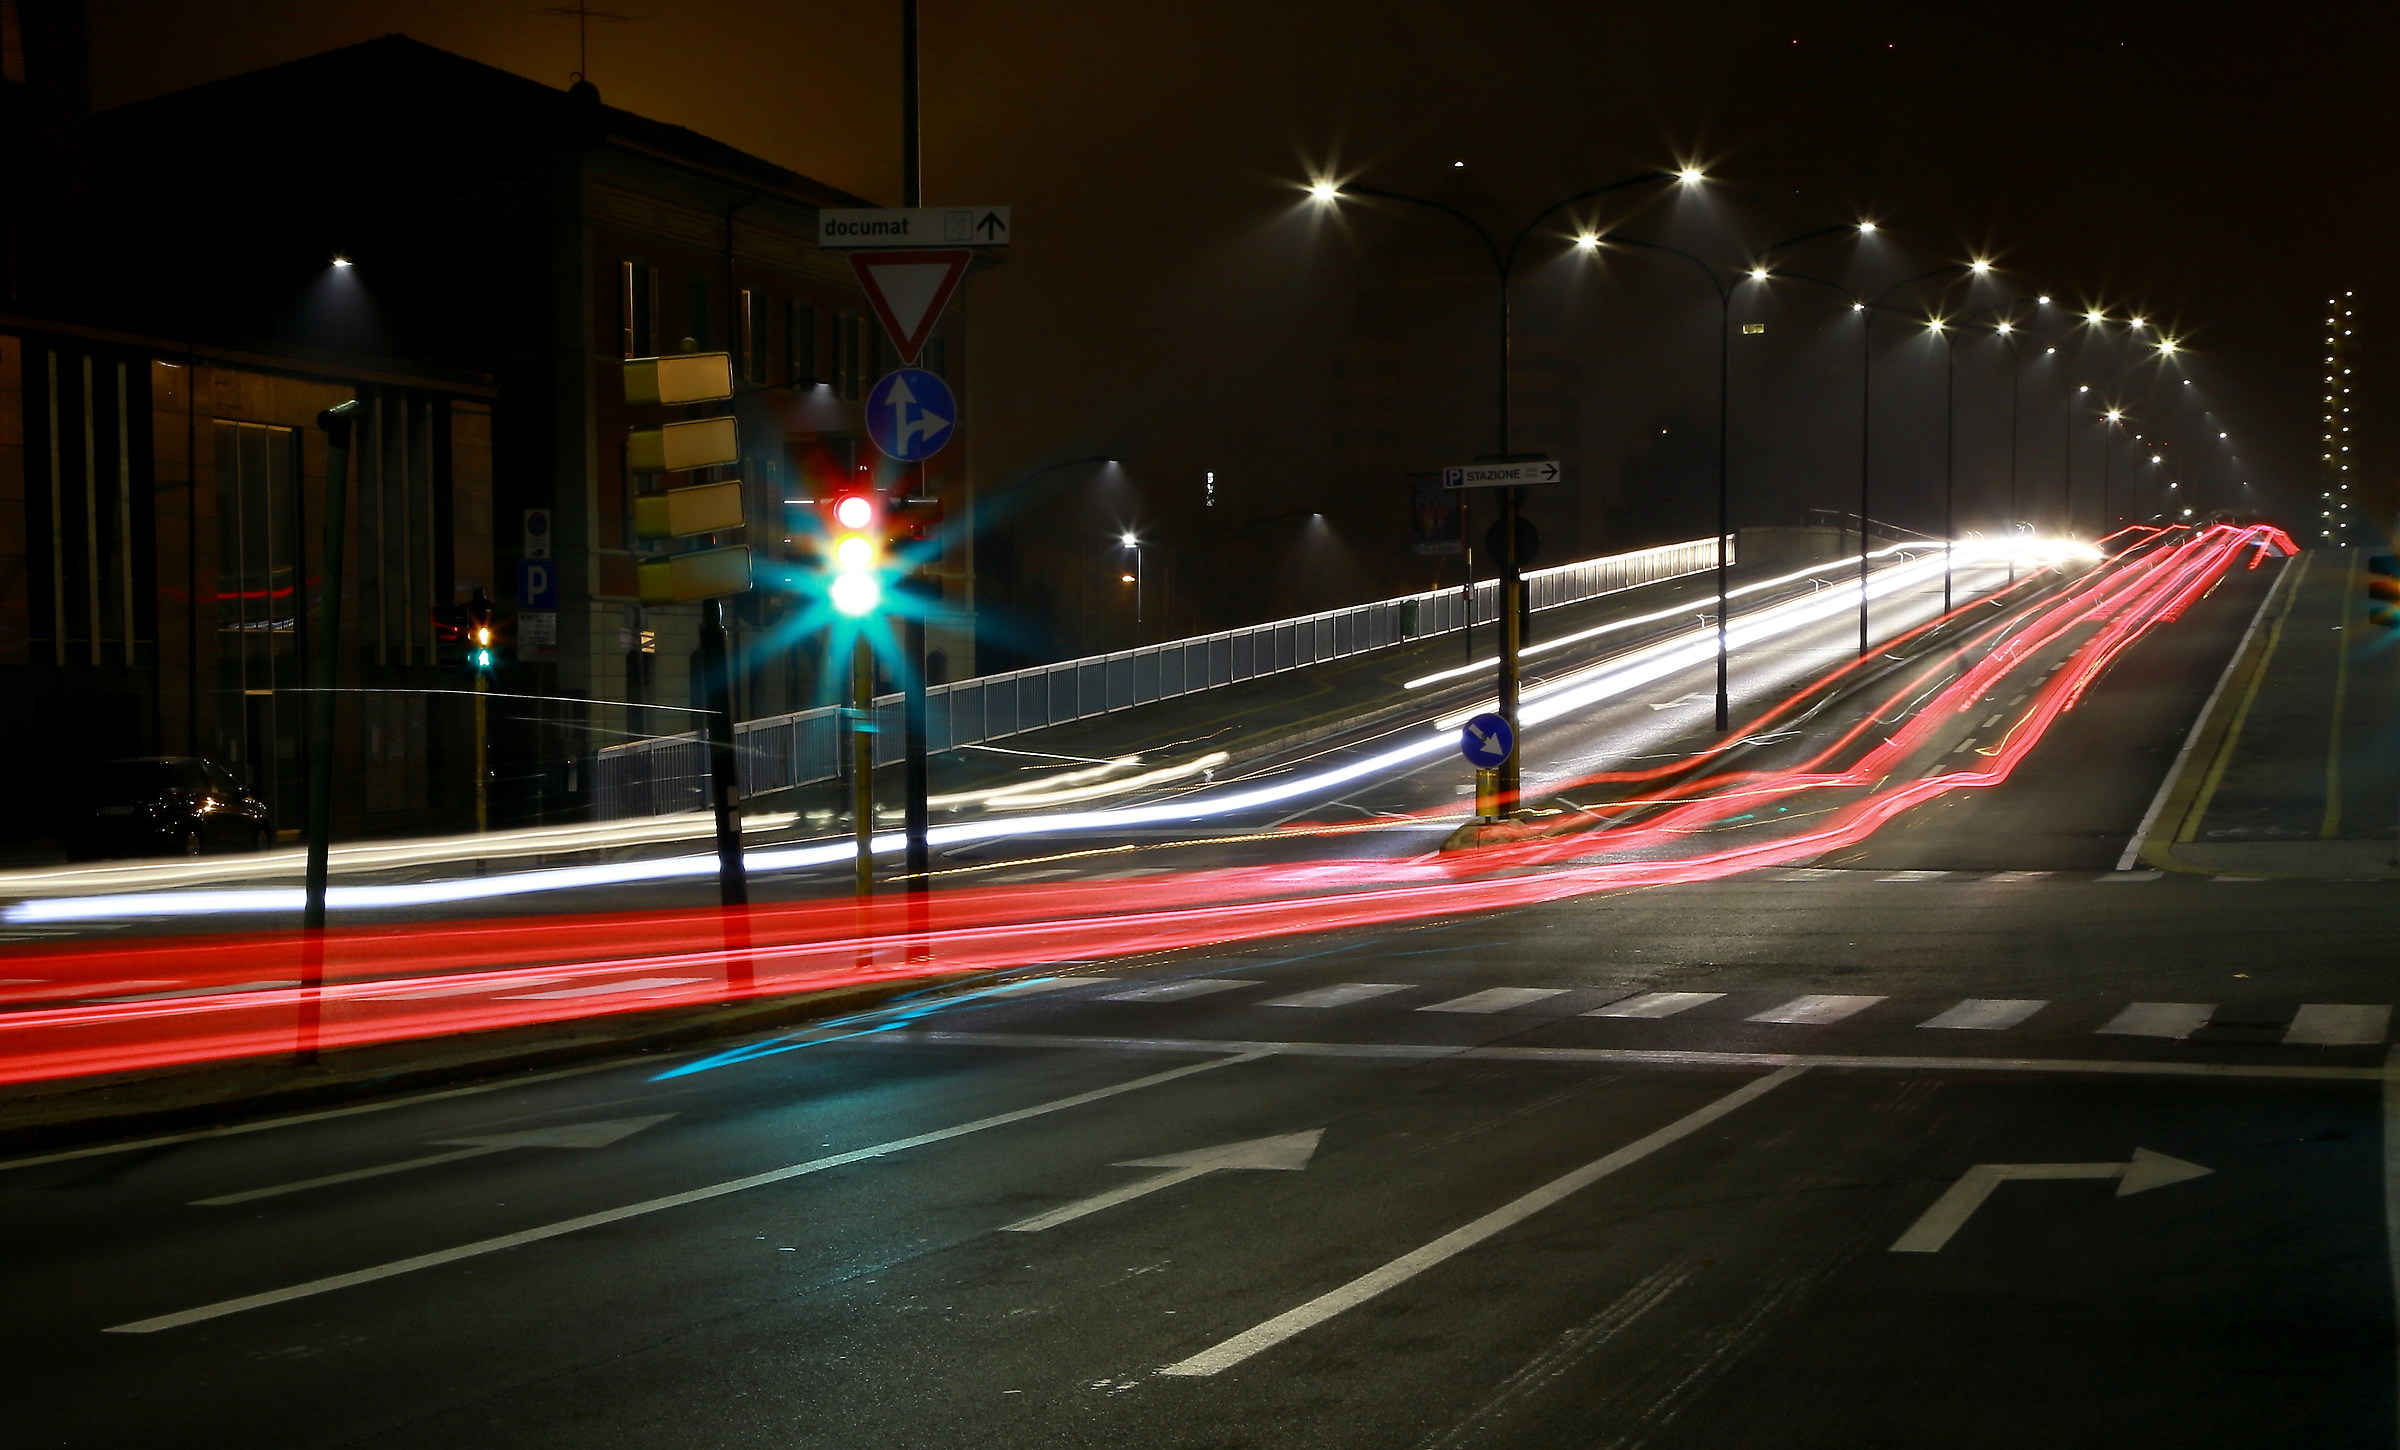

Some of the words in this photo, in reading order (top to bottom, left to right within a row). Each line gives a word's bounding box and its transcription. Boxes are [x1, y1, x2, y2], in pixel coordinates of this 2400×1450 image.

[825, 217, 909, 236] documat
[1449, 469, 1462, 486] P
[1467, 469, 1520, 482] STAZIONE
[527, 565, 548, 605] P
